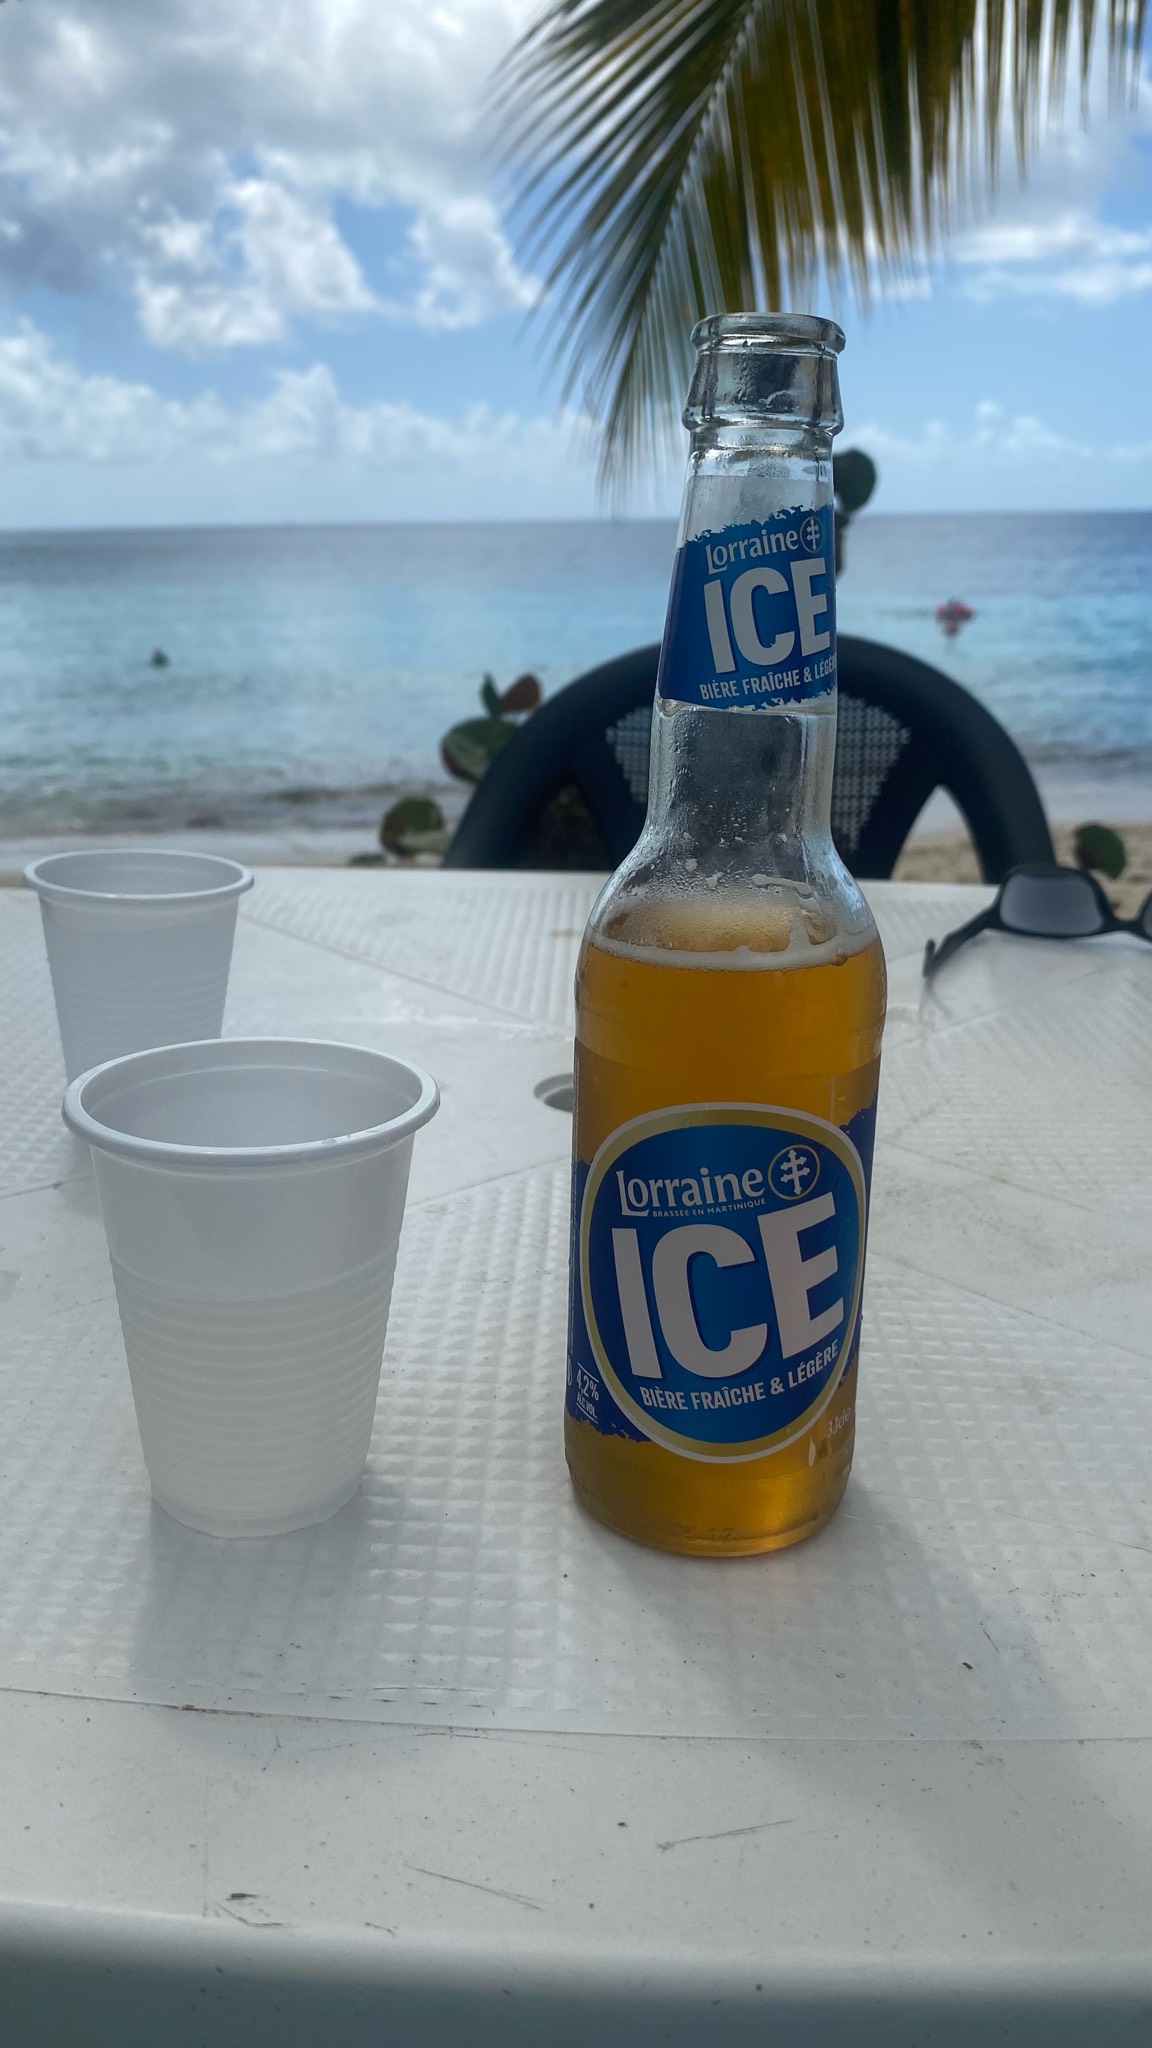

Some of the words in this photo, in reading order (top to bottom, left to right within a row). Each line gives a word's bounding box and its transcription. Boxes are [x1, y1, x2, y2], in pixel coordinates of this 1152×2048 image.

[705, 528, 799, 575] Lorraine
[703, 557, 831, 674] ICE
[699, 679, 740, 700] BIÈRE
[742, 668, 801, 695] FRAÎCHE
[803, 666, 813, 683] &
[615, 1166, 766, 1217] Lorraine
[652, 1208, 690, 1218] BRASSÉE
[706, 1197, 766, 1215] MARTINIQUE
[611, 1191, 845, 1380] ICE
[639, 1384, 689, 1411] BIÈRE
[690, 1381, 767, 1410] FRAÎCHE
[770, 1376, 786, 1396] &
[788, 1338, 840, 1389] LÉGÈRE
